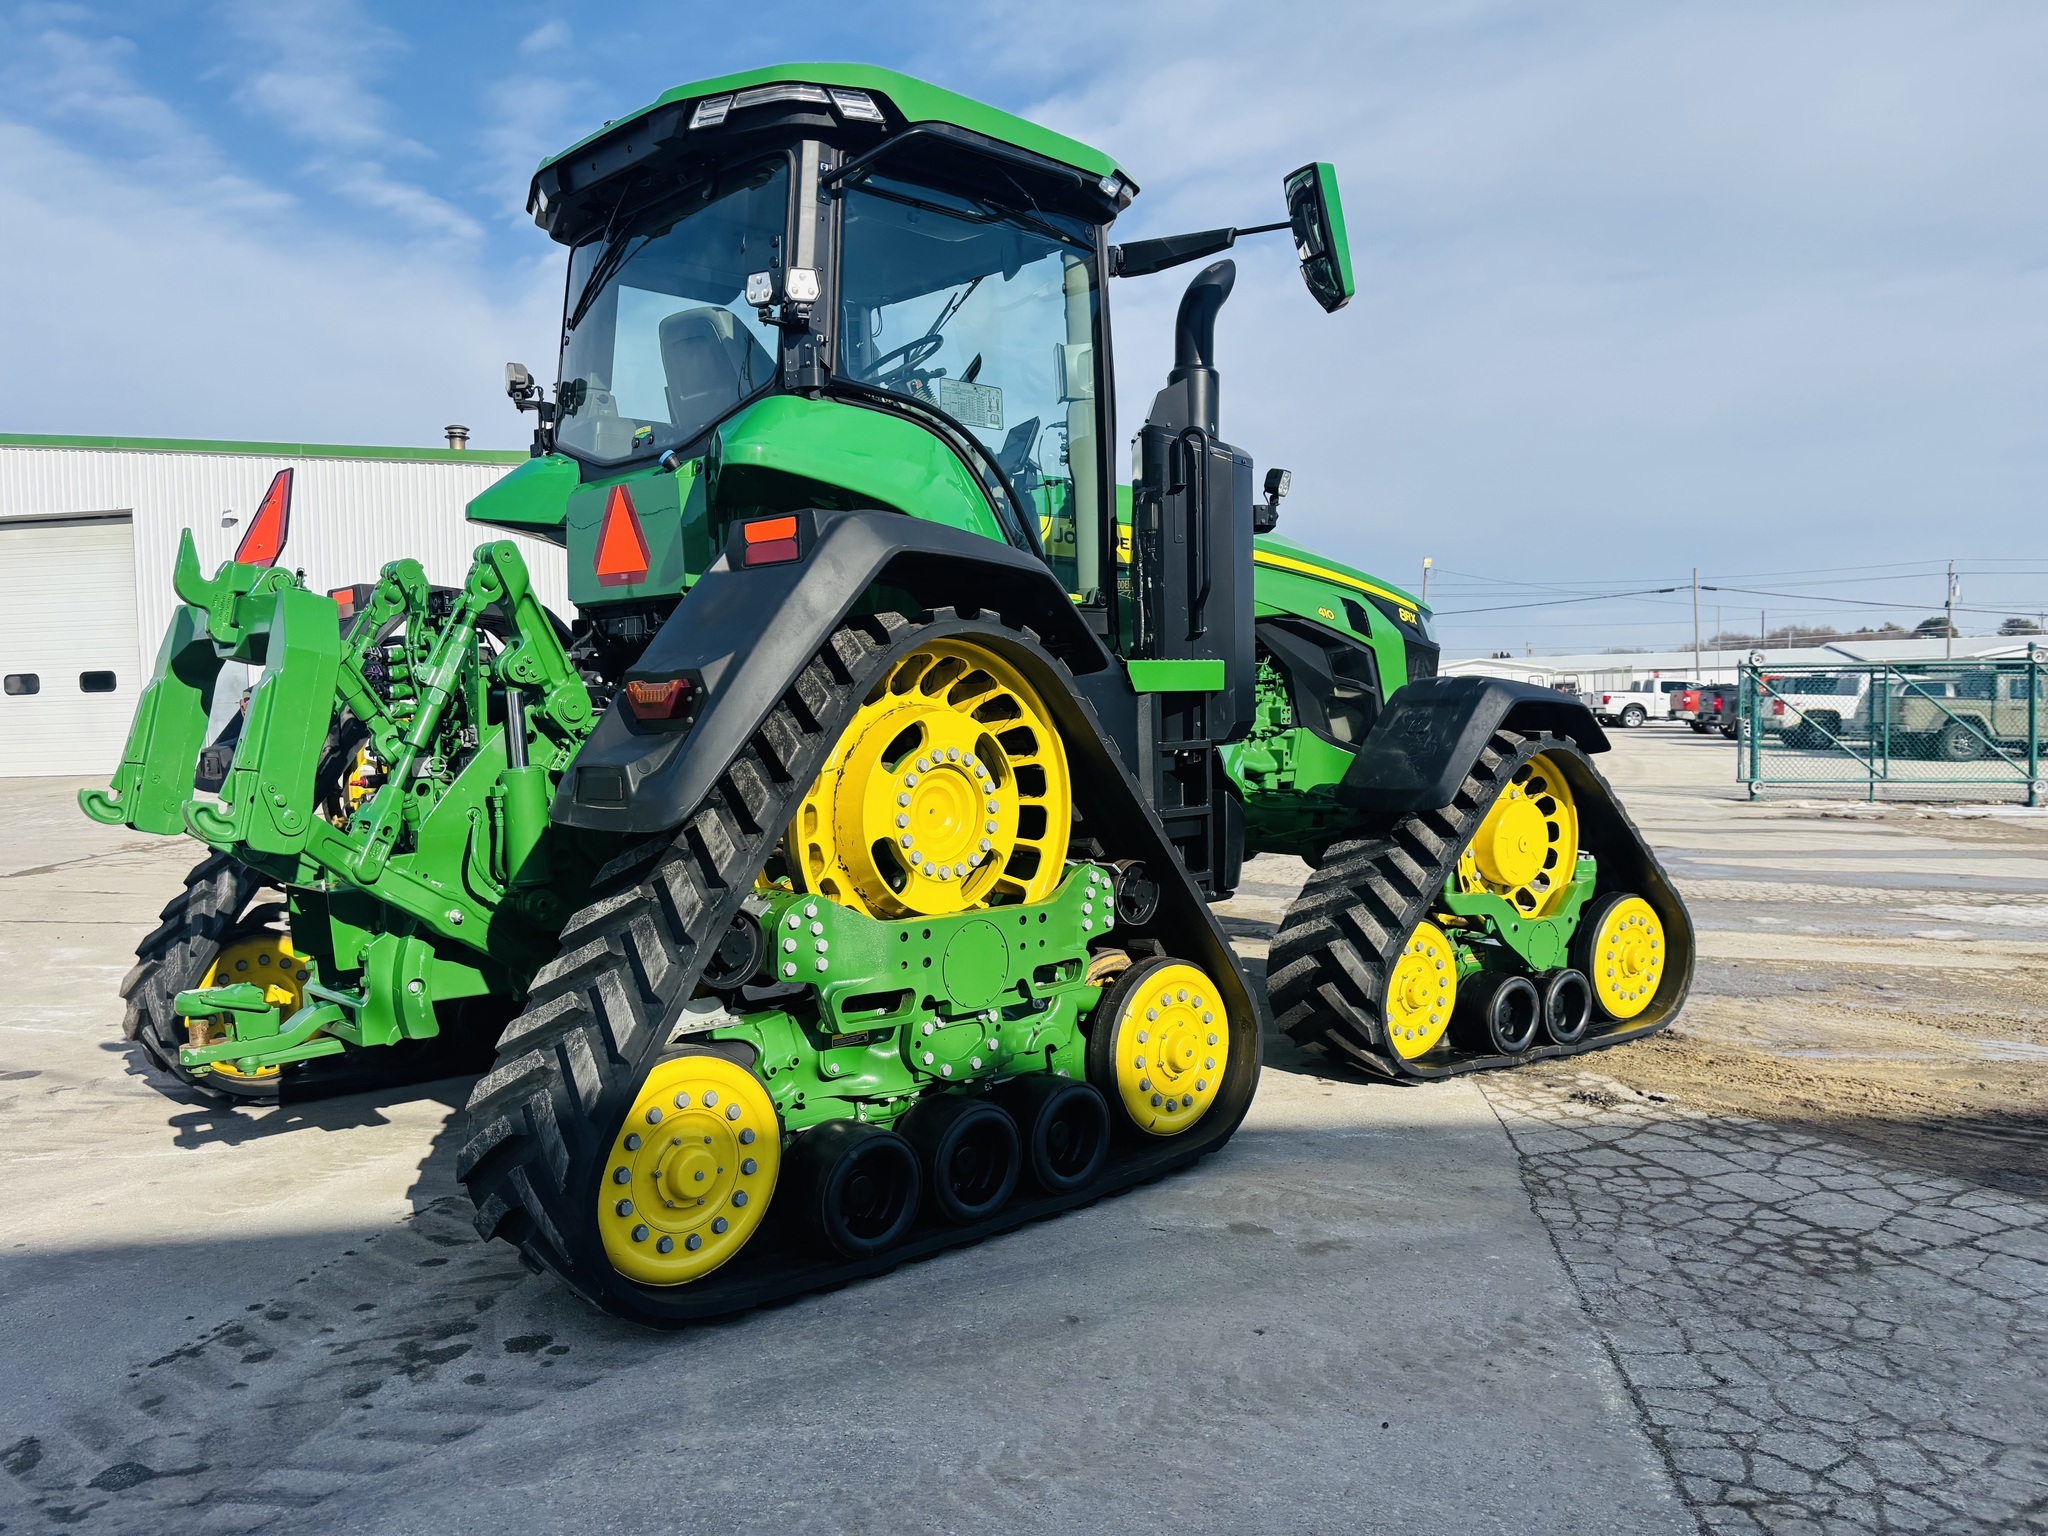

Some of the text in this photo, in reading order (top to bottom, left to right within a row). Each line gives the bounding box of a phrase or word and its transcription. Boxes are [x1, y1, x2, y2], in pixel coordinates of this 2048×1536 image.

[1054, 528, 1076, 544] JO
[1318, 607, 1334, 620] 410
[1399, 607, 1417, 625] 8RX
